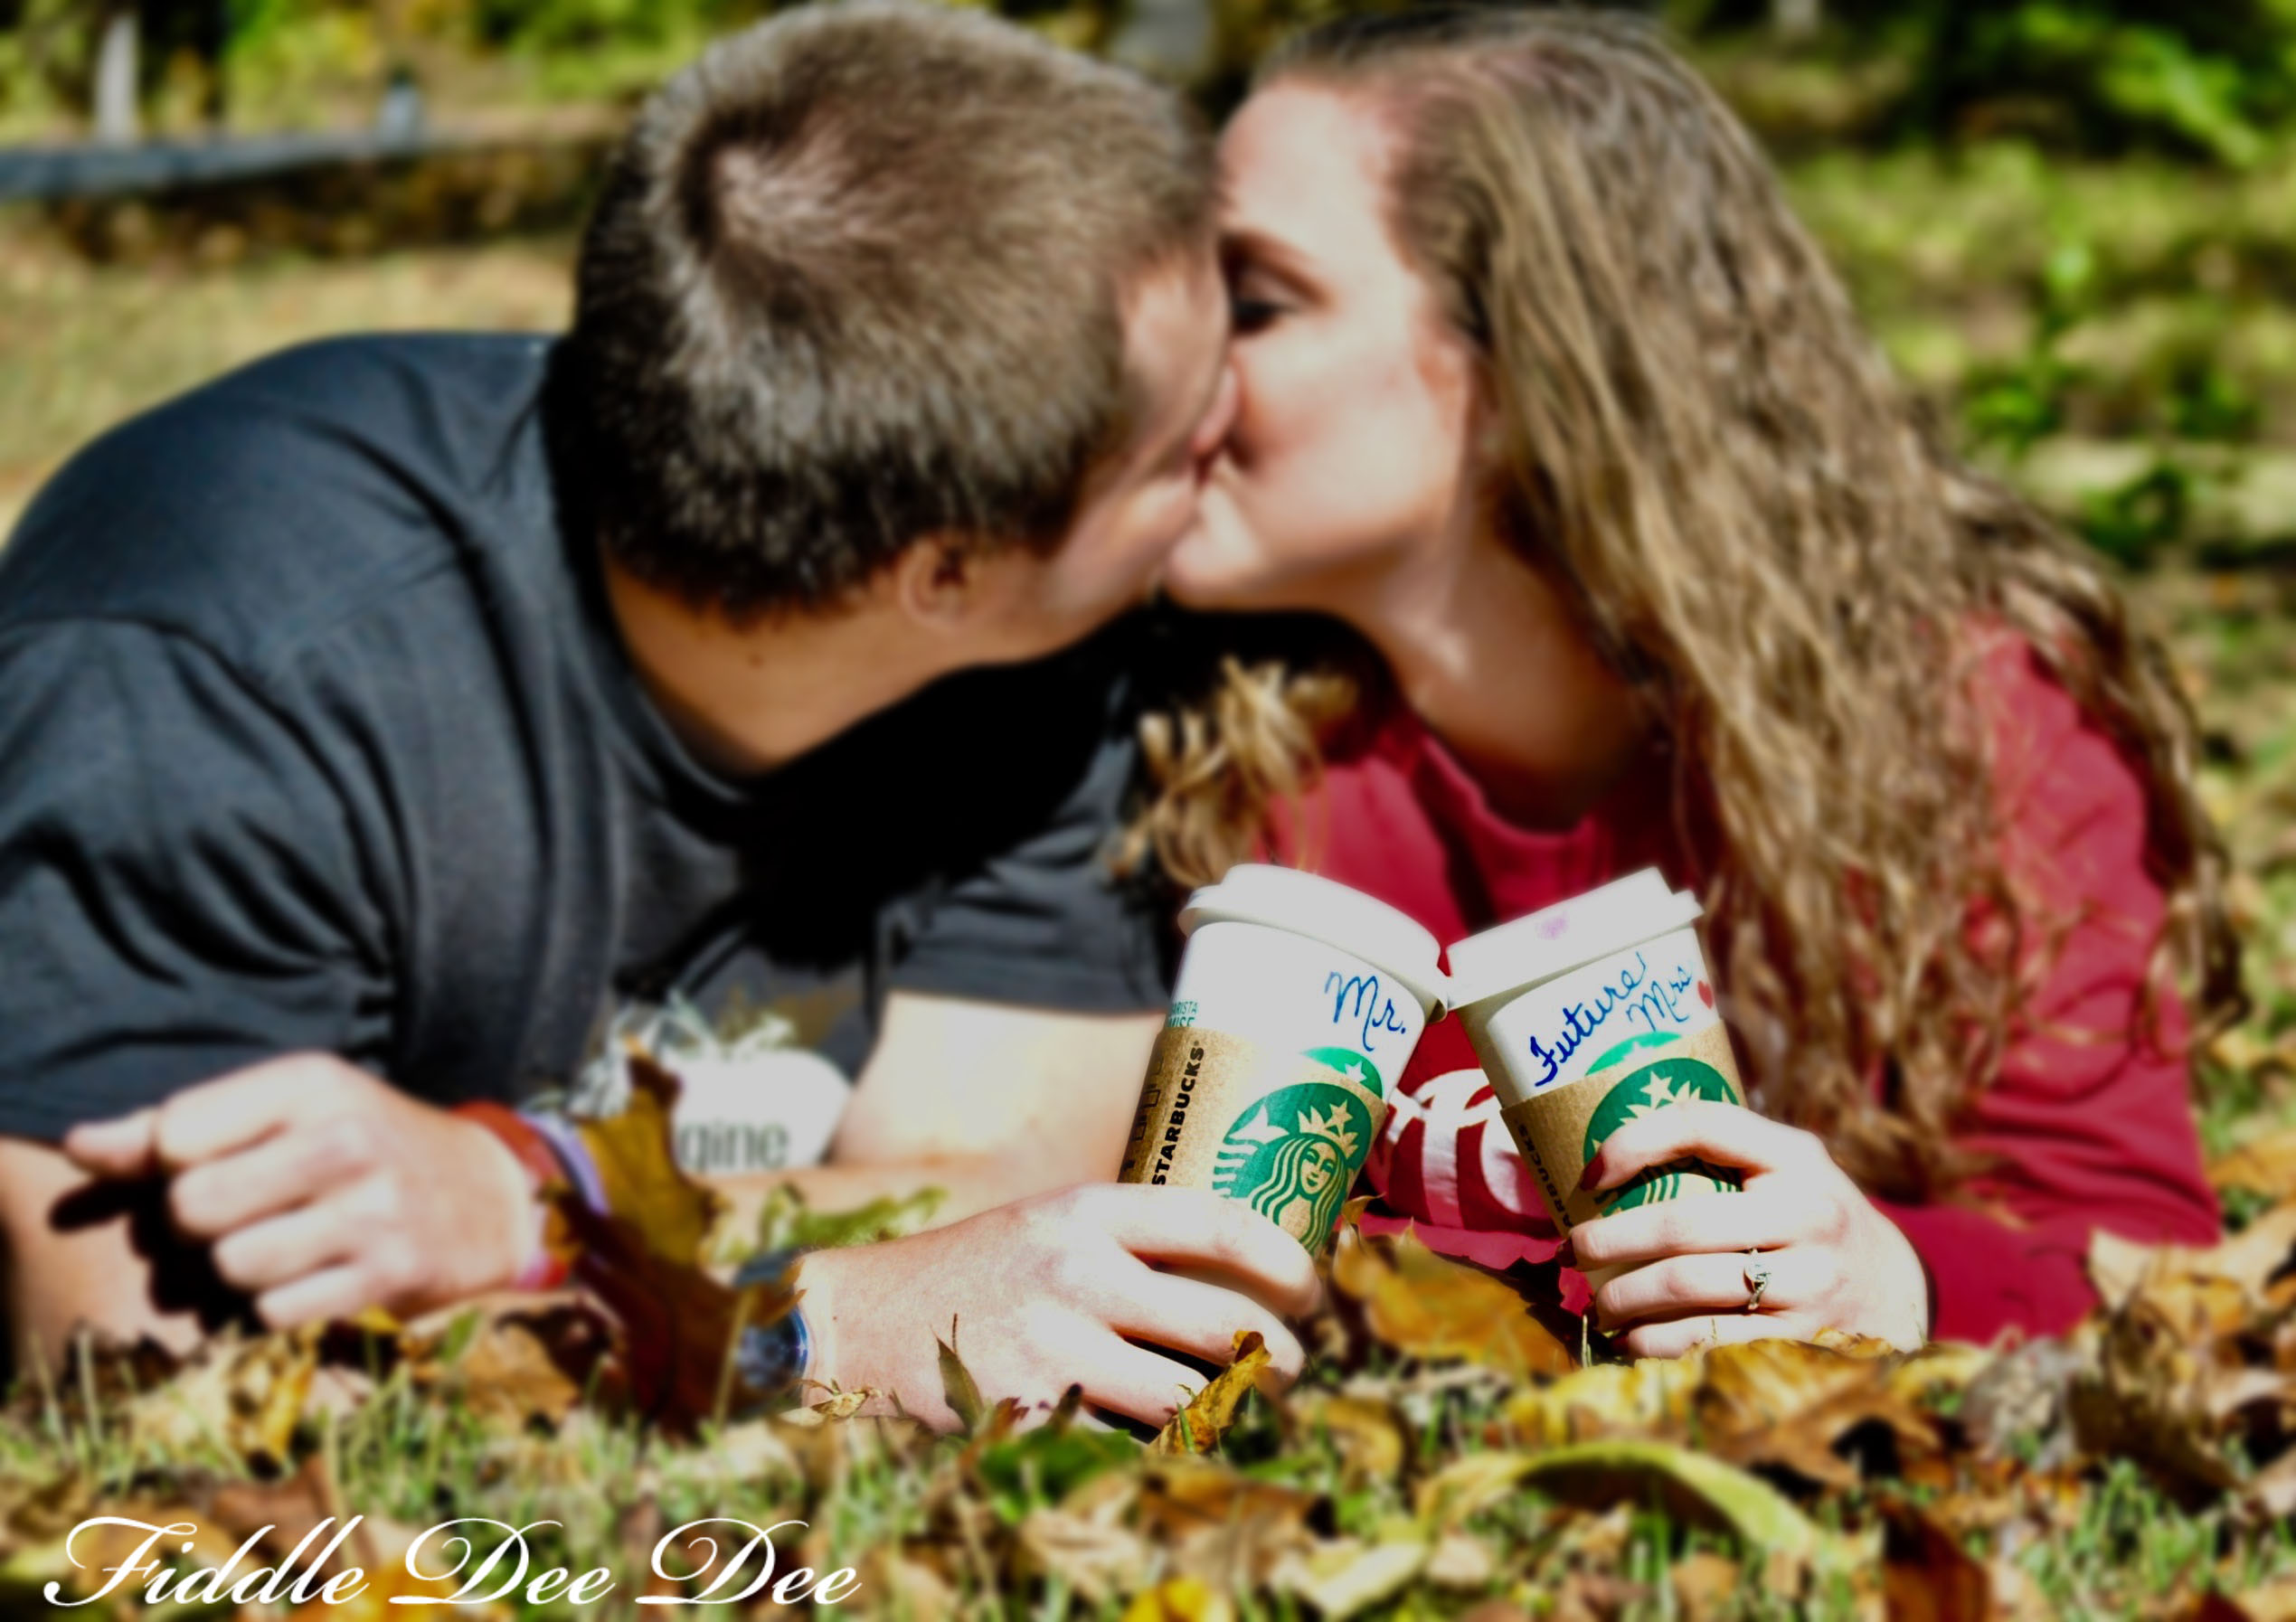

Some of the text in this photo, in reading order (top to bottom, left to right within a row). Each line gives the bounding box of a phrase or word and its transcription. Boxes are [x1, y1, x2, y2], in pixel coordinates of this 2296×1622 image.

[1324, 971, 1407, 1052] Mr.
[1529, 951, 1647, 1088] Future
[1151, 1047, 1205, 1185] STARBUCKS
